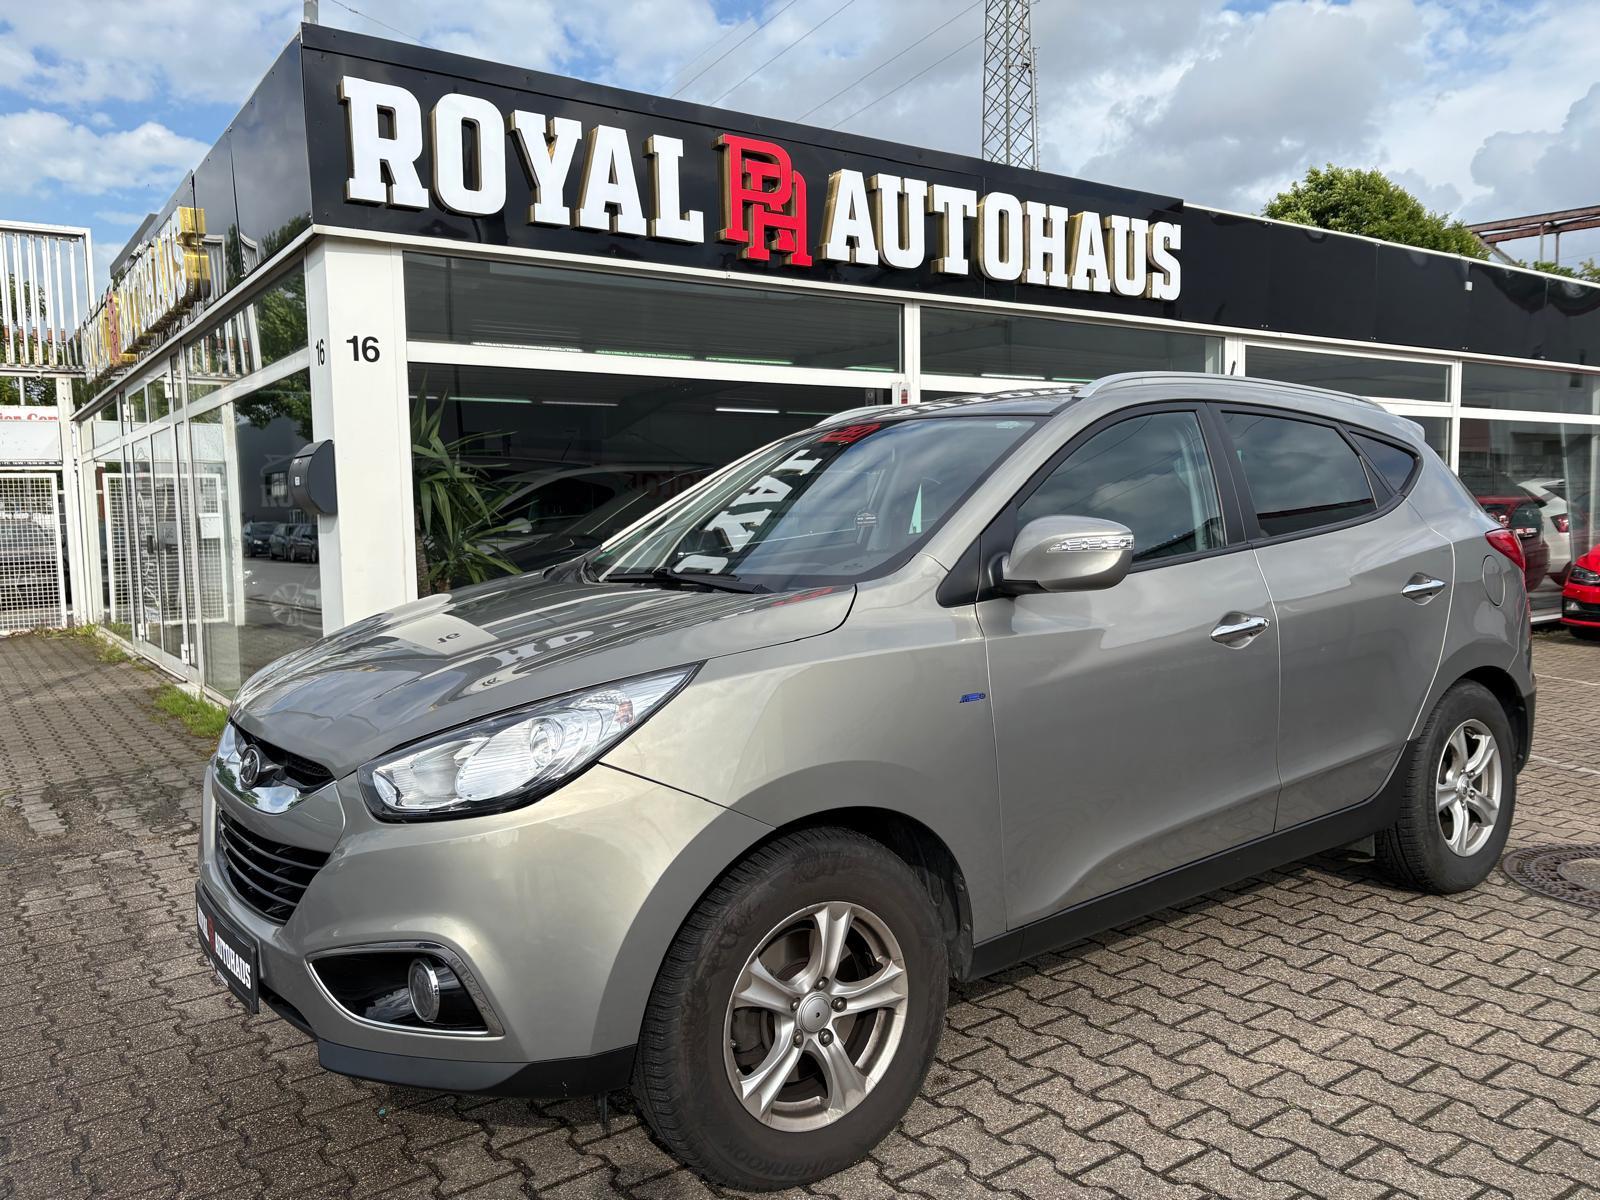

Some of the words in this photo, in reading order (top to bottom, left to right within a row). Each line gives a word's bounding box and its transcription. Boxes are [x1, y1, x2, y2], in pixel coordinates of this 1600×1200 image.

[341, 76, 704, 243] ROYAL
[824, 168, 1181, 301] AUTOHAUS
[315, 338, 325, 366] 16
[346, 335, 380, 363] 16
[215, 931, 252, 989] AUTOHAUS
